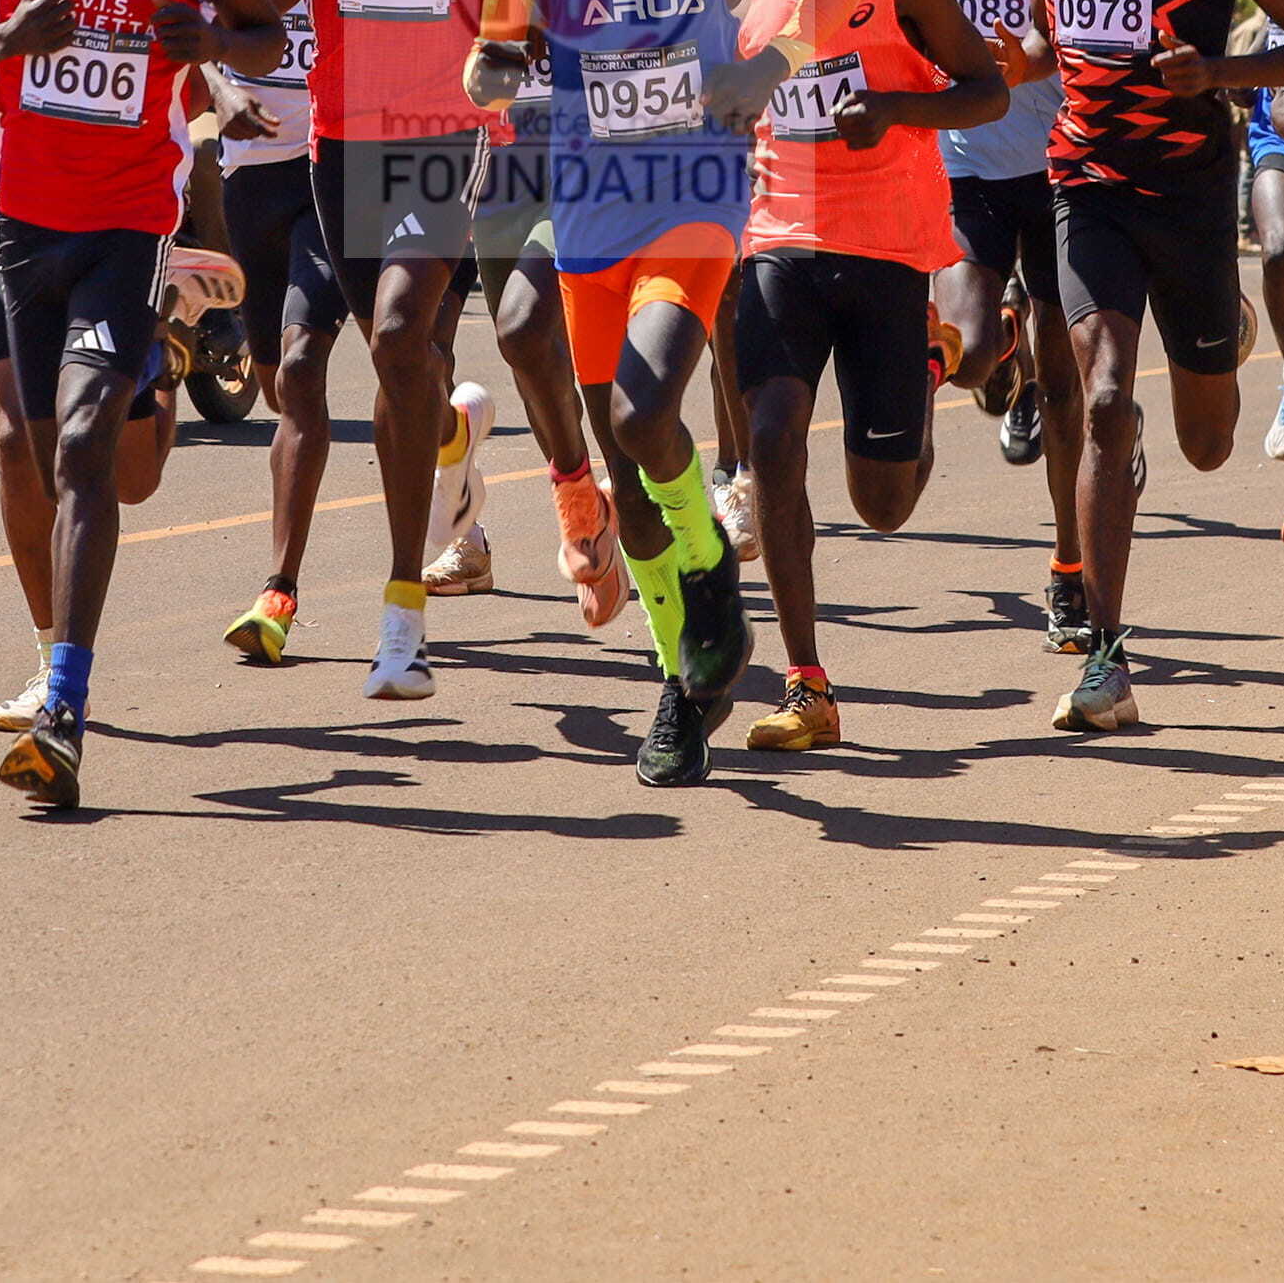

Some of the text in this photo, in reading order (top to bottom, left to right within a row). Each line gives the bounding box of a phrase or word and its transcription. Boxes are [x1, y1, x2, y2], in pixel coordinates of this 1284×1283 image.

[84, 38, 109, 51] RUN
[637, 58, 661, 70] RUN
[30, 53, 136, 101] 0606
[799, 68, 820, 79] RUN
[589, 71, 696, 120] 0954
